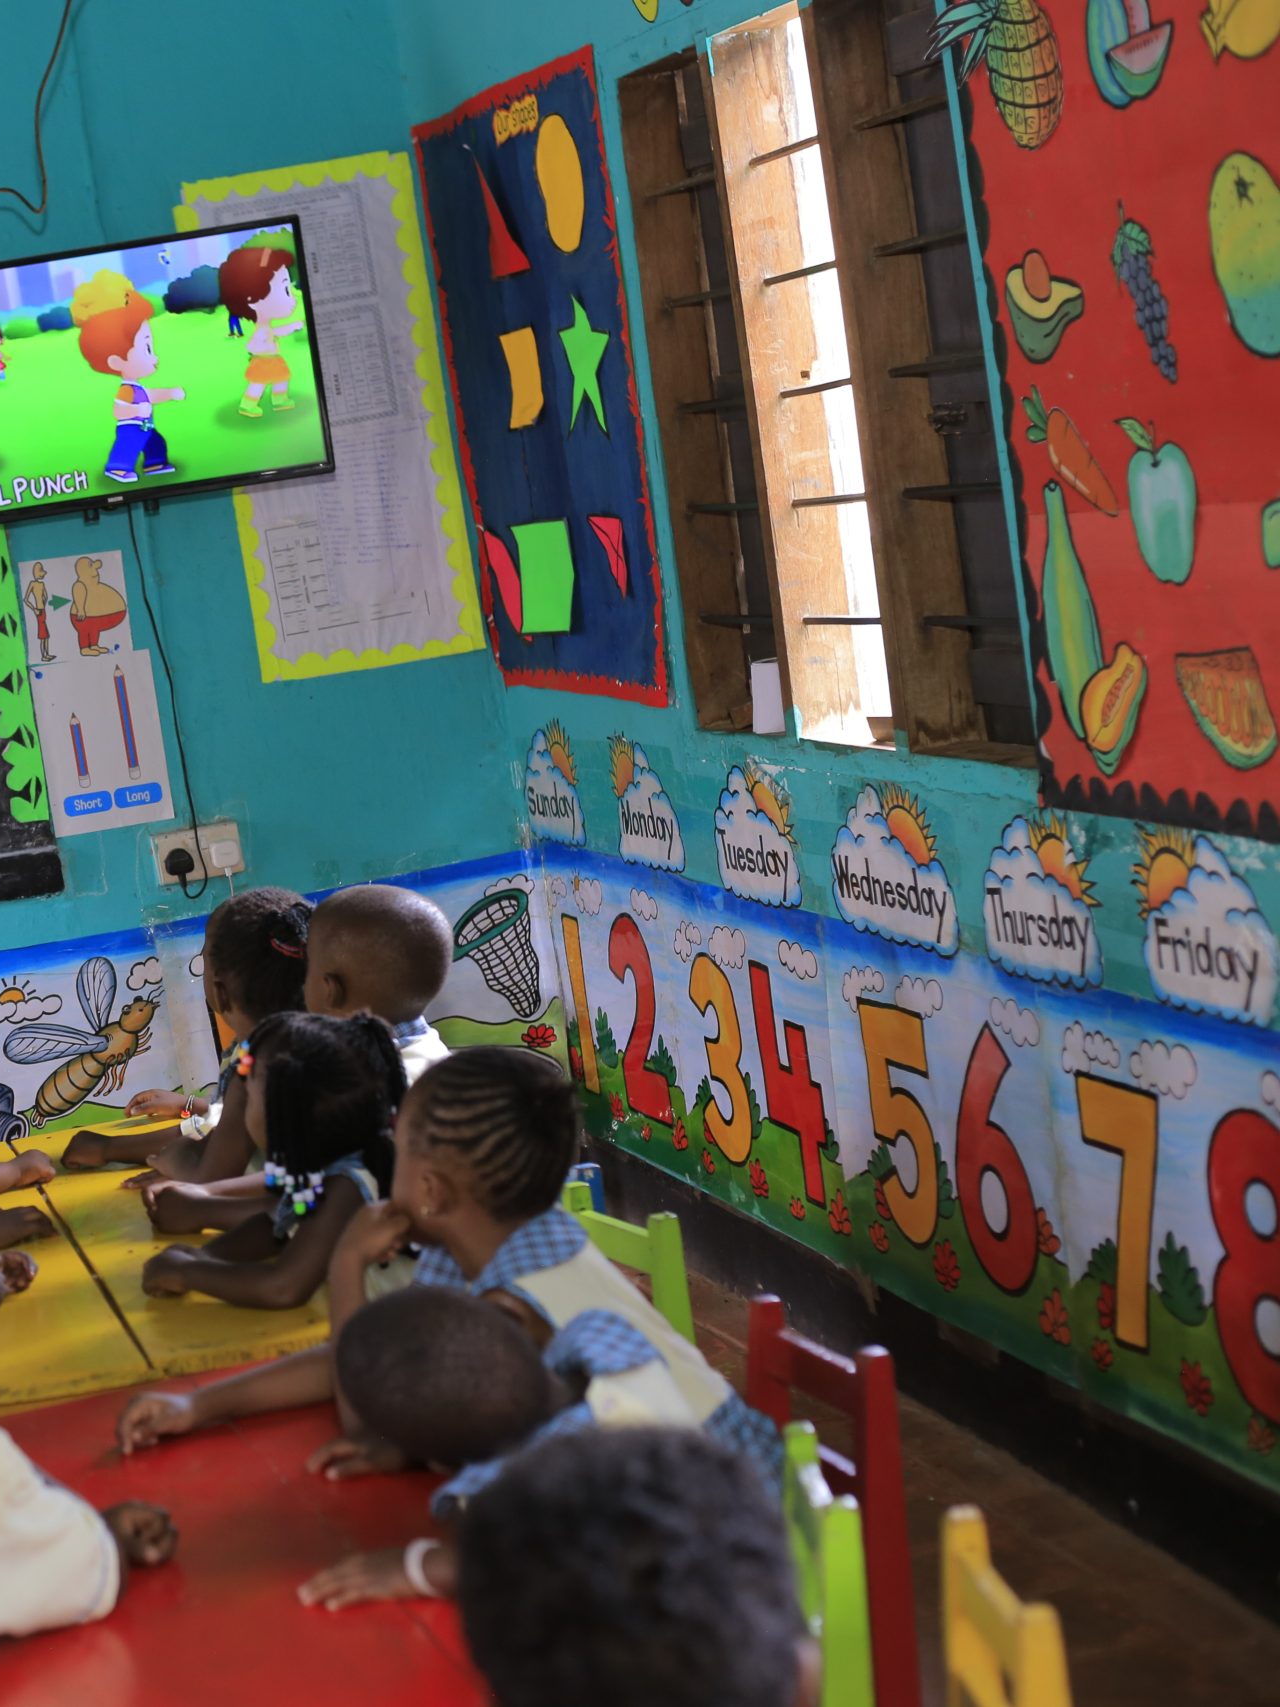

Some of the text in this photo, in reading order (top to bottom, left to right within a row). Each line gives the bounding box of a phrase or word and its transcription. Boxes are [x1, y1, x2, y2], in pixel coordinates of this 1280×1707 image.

[13, 469, 89, 503] PUNCH
[73, 795, 104, 811] Short
[126, 788, 151, 804] Long
[527, 785, 576, 841] Sunday
[620, 798, 674, 861] Monday
[717, 829, 789, 902] Tuesday
[831, 853, 948, 944] Wednesday
[985, 886, 1091, 978] Thursday
[1153, 917, 1260, 1012] Friday
[561, 911, 1280, 1426] 1 2 3 4 5 6 7 8
